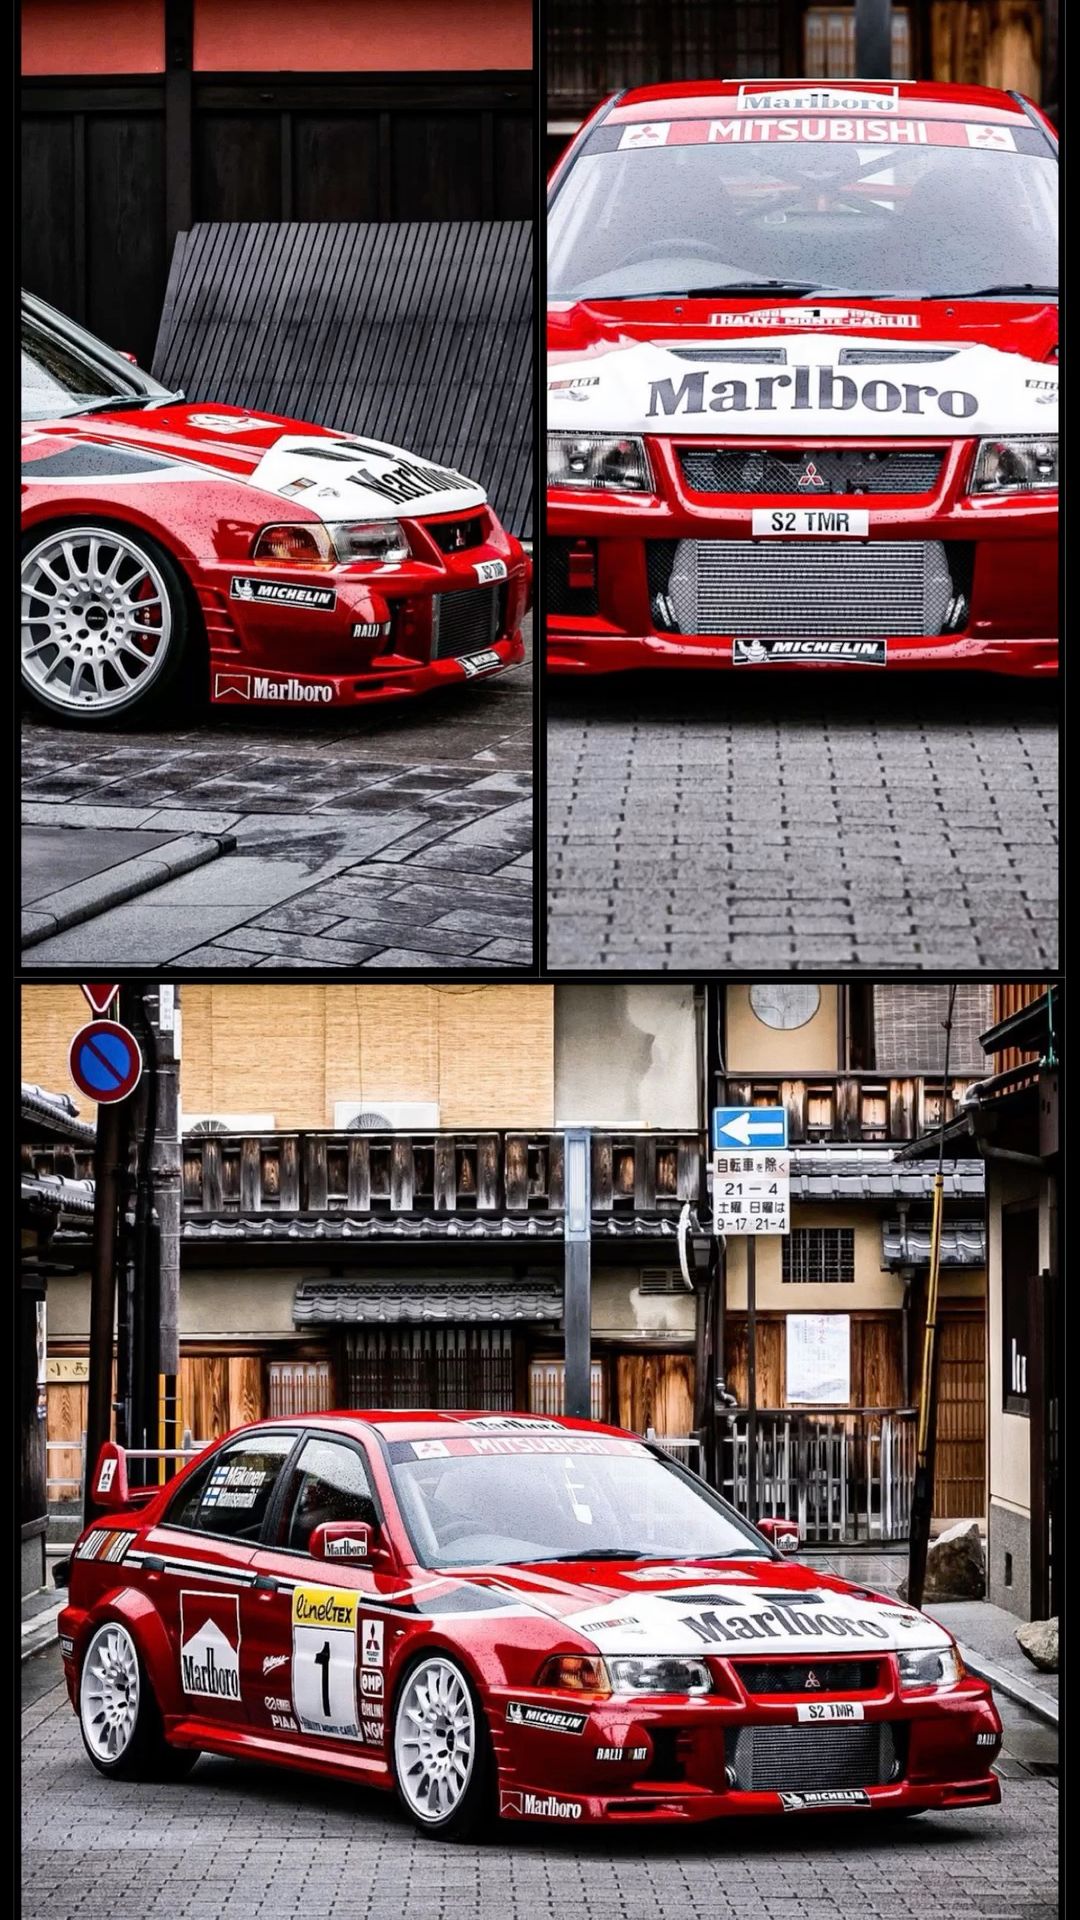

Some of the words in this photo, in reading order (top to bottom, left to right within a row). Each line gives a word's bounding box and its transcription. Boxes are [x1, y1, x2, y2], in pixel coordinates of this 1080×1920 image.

[744, 94, 894, 110] Marlboro
[708, 119, 927, 143] MITSUBISHI
[721, 315, 780, 326] RALLYE
[644, 365, 979, 418] Marlboro
[771, 512, 796, 532] S2
[804, 512, 850, 532] TMR
[257, 585, 331, 604] MICHELIN
[353, 623, 379, 638] RALLI
[772, 642, 878, 655] MICHELIN
[253, 677, 333, 703] Marlboro
[718, 1157, 785, 1173] 自転車を除く
[469, 1438, 610, 1454] MITSUBISHI
[327, 1540, 366, 1555] Marlboro
[678, 1605, 889, 1644] Marlboro
[183, 1647, 239, 1697] Marlboro
[314, 1641, 331, 1717] 1
[362, 1674, 382, 1692] OMP
[525, 1710, 583, 1728] MICHELIN
[808, 1705, 825, 1718] S2
[828, 1704, 855, 1718] TMR
[271, 1714, 298, 1731] PIAA
[596, 1747, 623, 1761] RALLI
[632, 1747, 648, 1760] ART
[804, 1791, 864, 1802] MICHELIN
[525, 1794, 582, 1819] Marlboro
